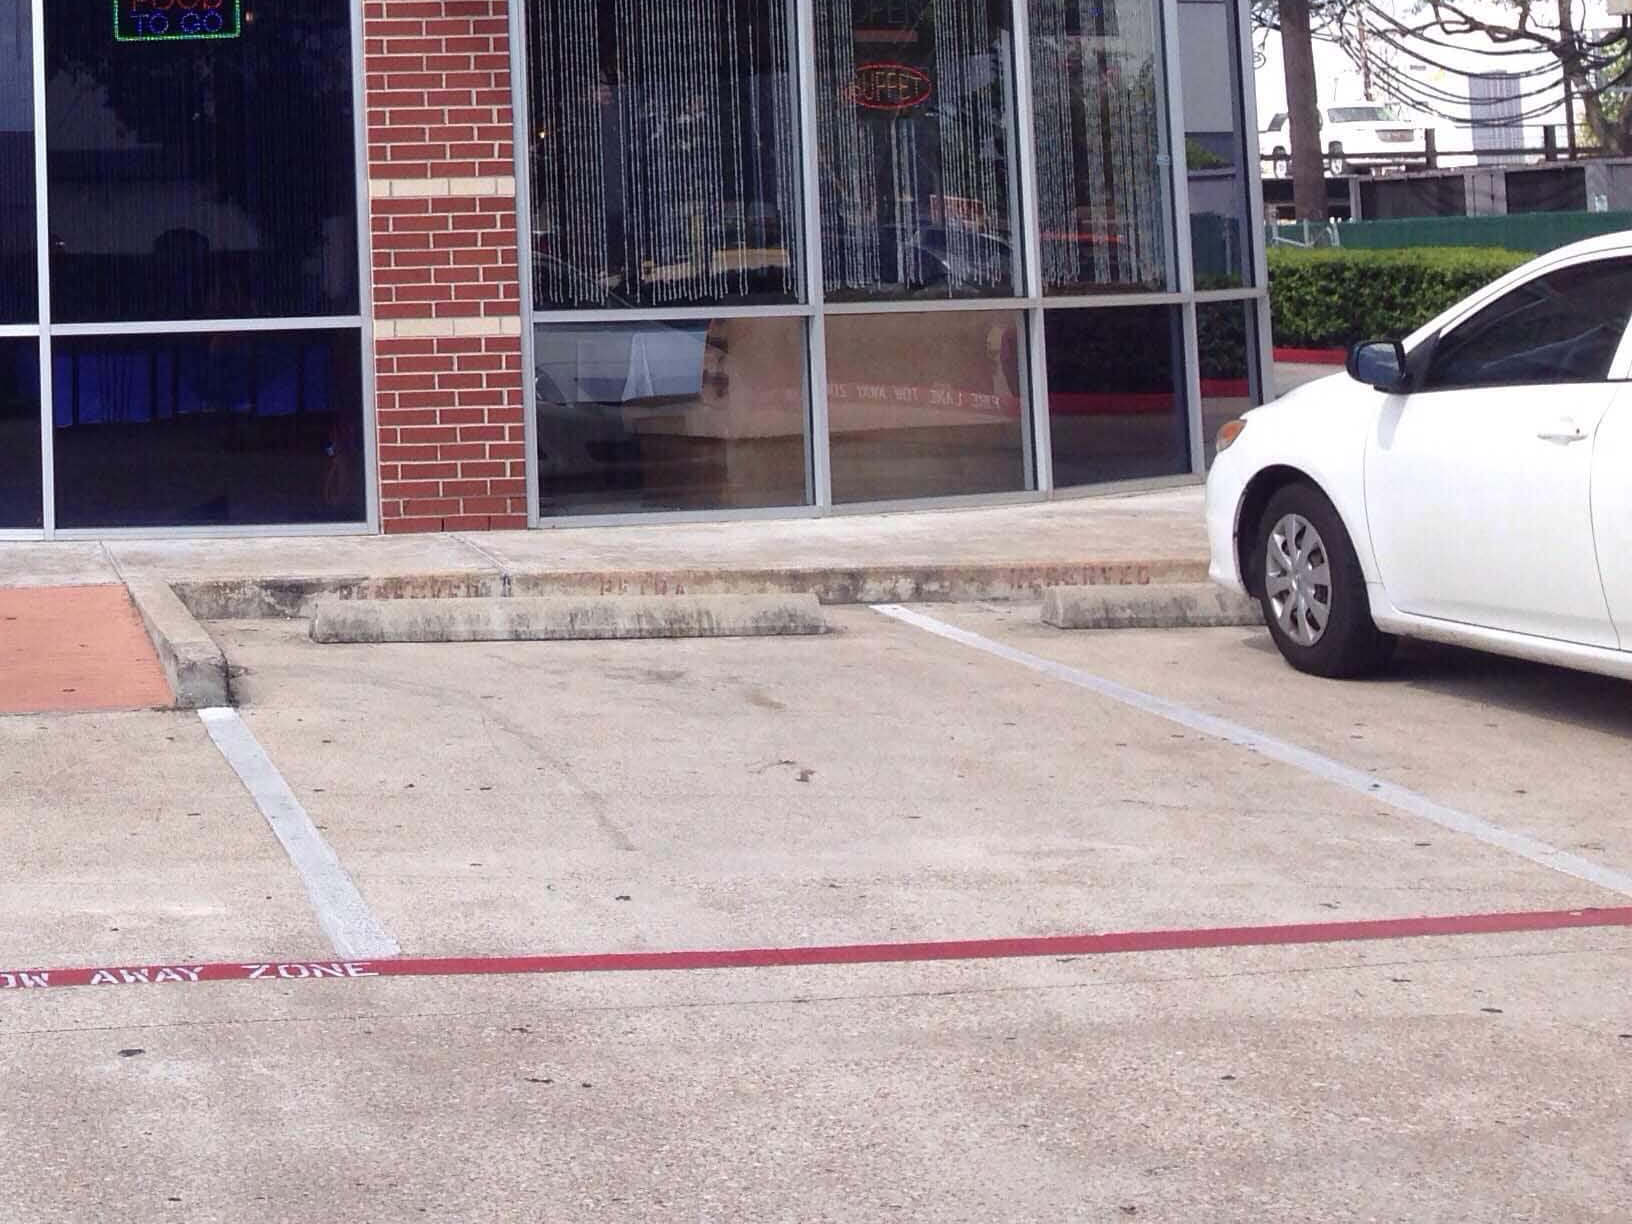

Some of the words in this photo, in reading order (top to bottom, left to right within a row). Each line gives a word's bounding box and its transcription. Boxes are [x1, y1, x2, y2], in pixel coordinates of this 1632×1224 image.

[130, 12, 169, 35] TO
[180, 10, 223, 34] GO
[90, 965, 206, 986] AWAY
[241, 960, 382, 979] ZONE
